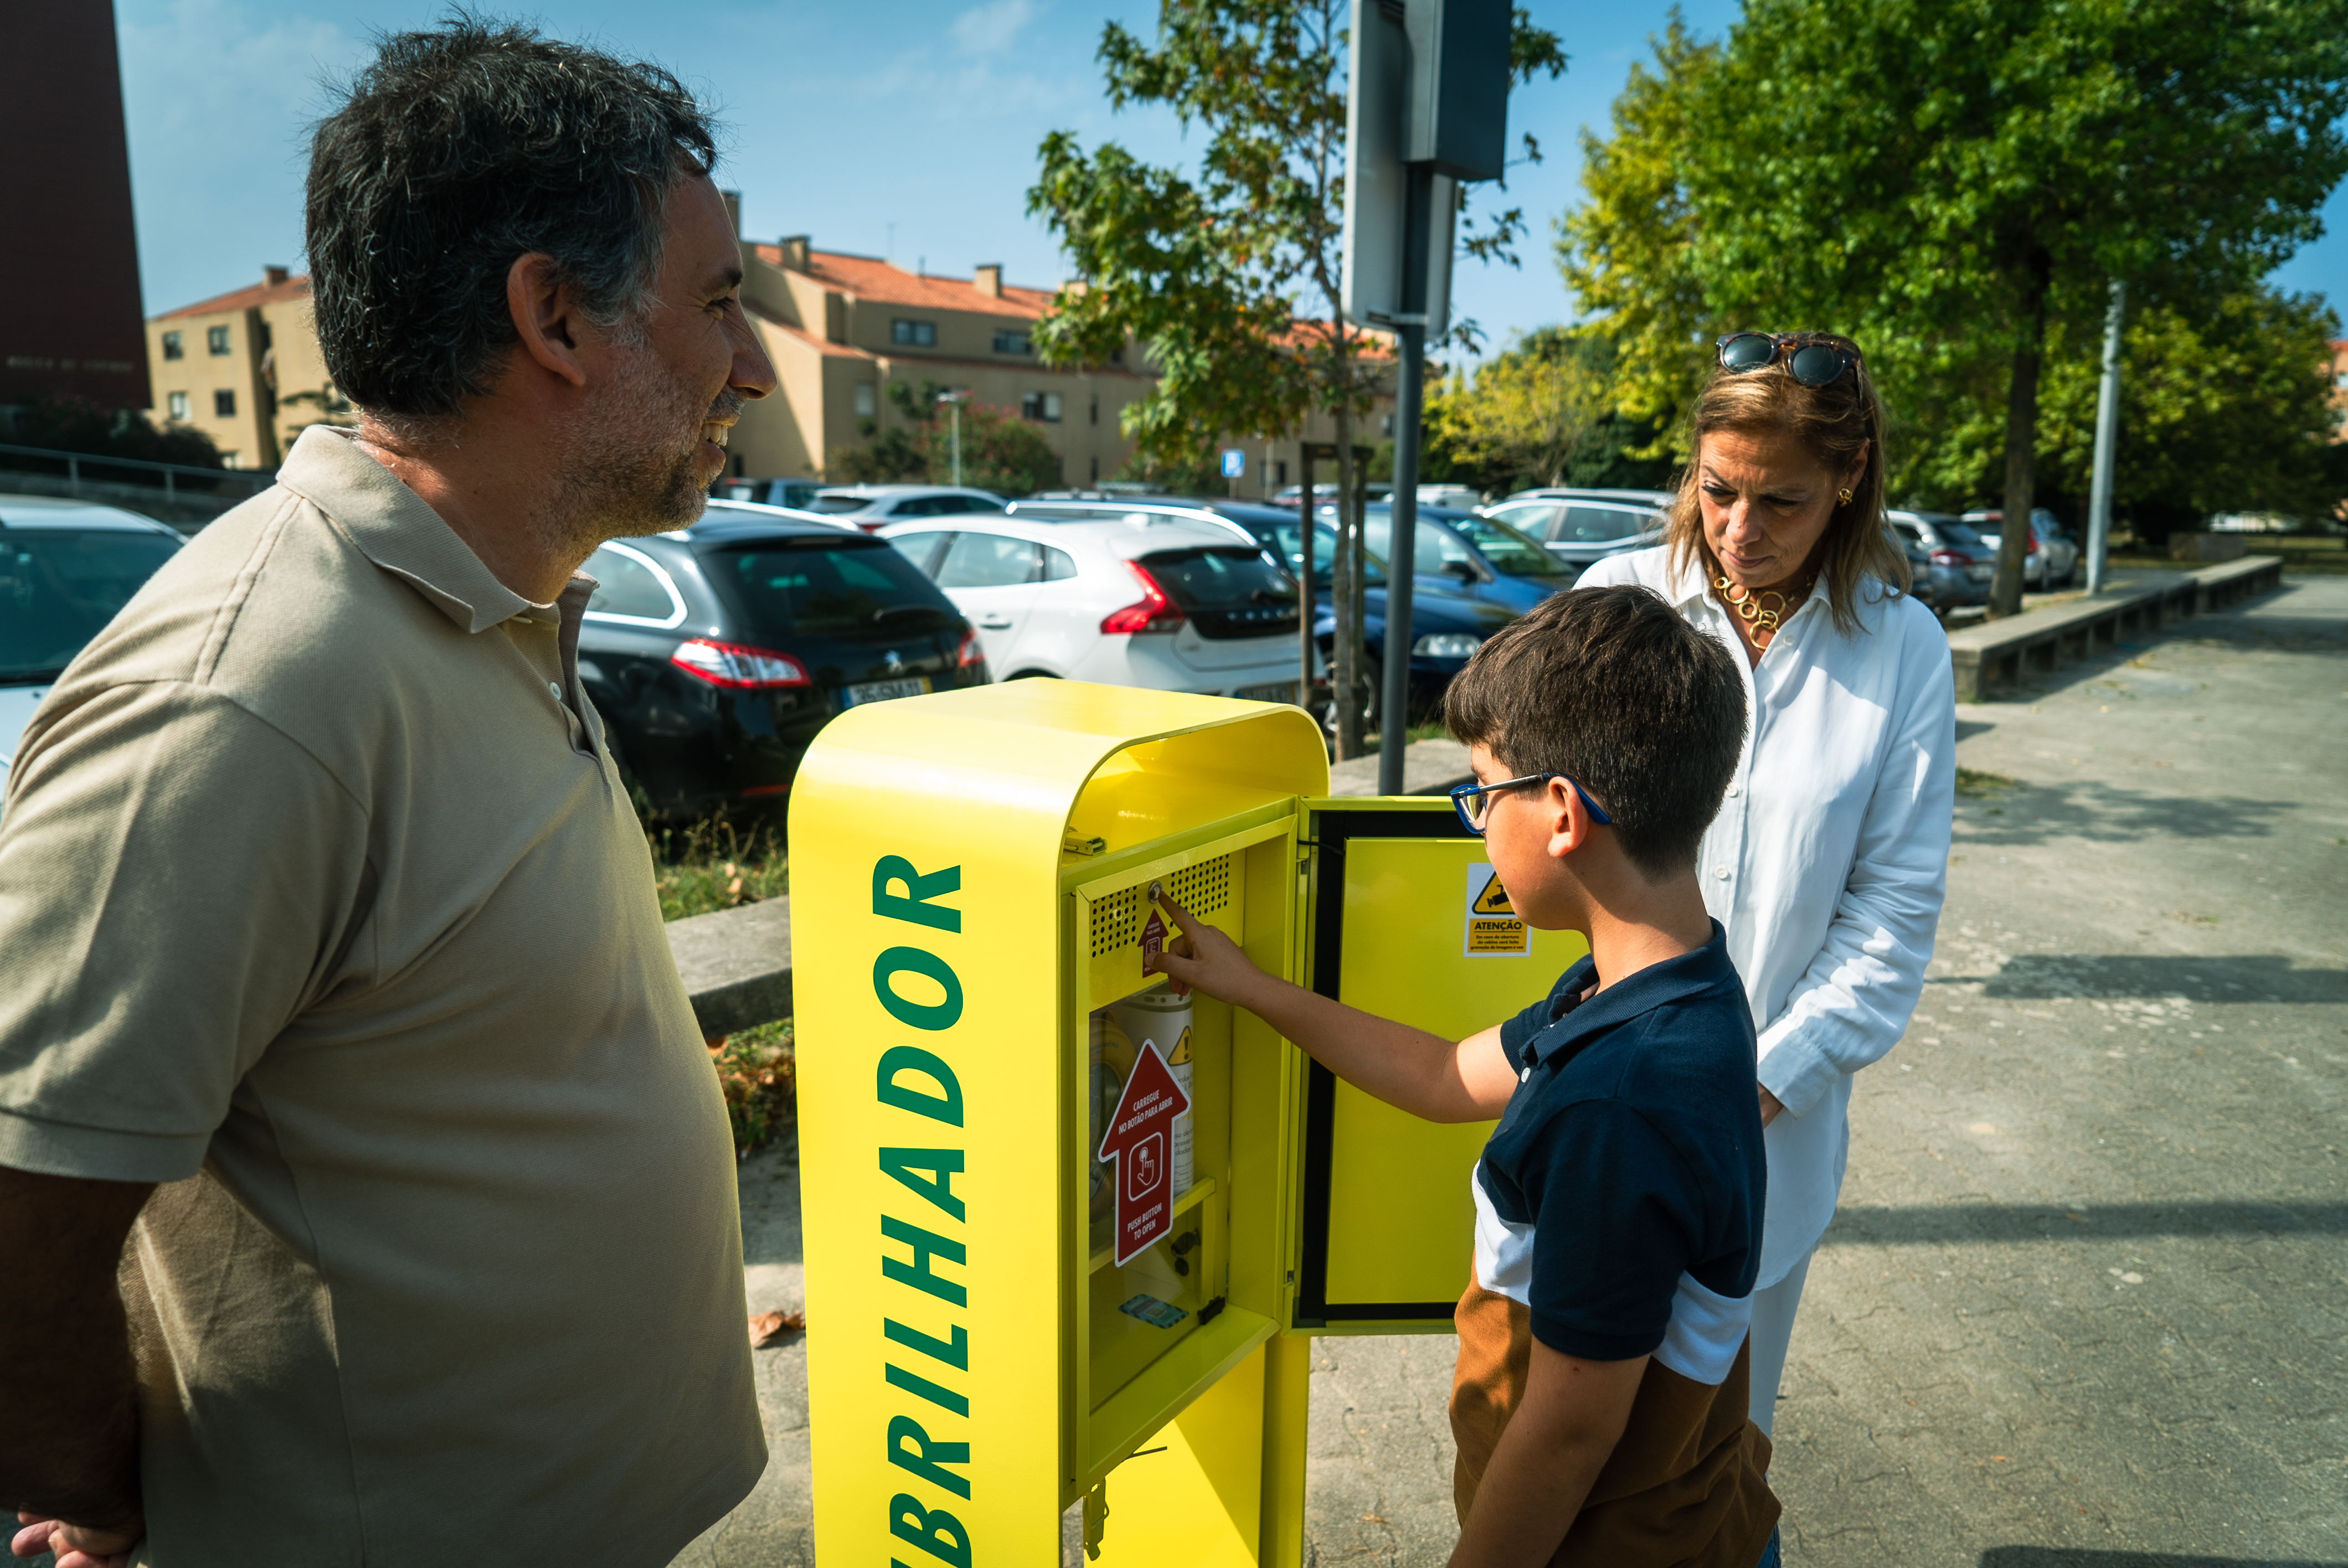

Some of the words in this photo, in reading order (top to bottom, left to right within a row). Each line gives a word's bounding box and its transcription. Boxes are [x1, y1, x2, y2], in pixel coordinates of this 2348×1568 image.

[1474, 920, 1522, 931] ATENÇÃO
[1133, 1090, 1160, 1111] CARREGUE
[1119, 1122, 1127, 1134] NO
[1127, 1112, 1144, 1129] BOTÃO
[1145, 1105, 1158, 1120] PARA
[1158, 1096, 1172, 1112] ABRIR
[873, 855, 971, 1568] BRILHADOR
[1127, 1216, 1141, 1232] PUSH
[1142, 1202, 1162, 1223] BUTTON
[1134, 1229, 1141, 1240] TO
[1142, 1219, 1156, 1235] OPEN
